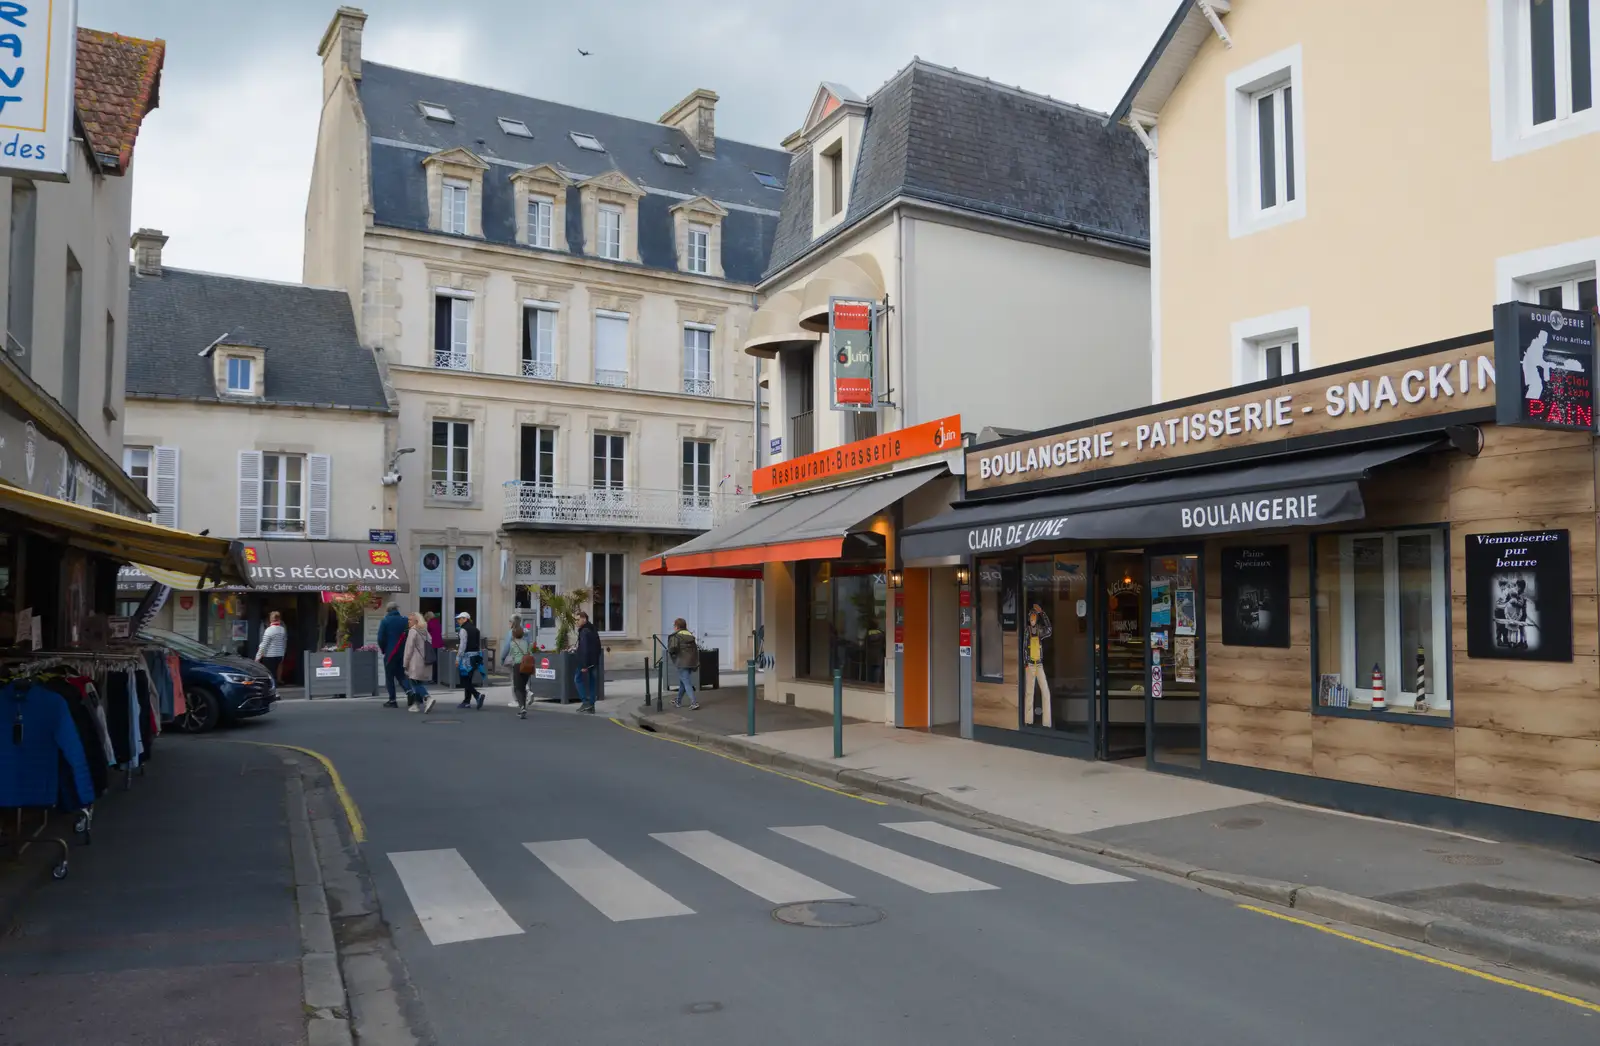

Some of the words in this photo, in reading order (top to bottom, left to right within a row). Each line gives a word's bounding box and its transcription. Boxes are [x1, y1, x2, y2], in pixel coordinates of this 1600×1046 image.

[0, 133, 46, 160] des
[1531, 312, 1585, 328] BOULANGERIE
[1570, 338, 1591, 346] Artisan
[1529, 399, 1592, 427] PAIN
[980, 431, 1114, 479] BOULANGERIE
[1136, 395, 1294, 451] PATISSERIE
[1181, 494, 1317, 528] BOULANGERIE
[968, 527, 1002, 550] CLAIR
[1006, 523, 1025, 546] DE
[1025, 517, 1068, 541] LUNE
[1477, 532, 1558, 544] Viennoiseries
[1242, 549, 1264, 558] Pains
[1504, 547, 1527, 558] pur
[1234, 559, 1272, 570] Spéciaux
[1496, 557, 1537, 568] beurre
[290, 565, 399, 579] RÉGIONAUX
